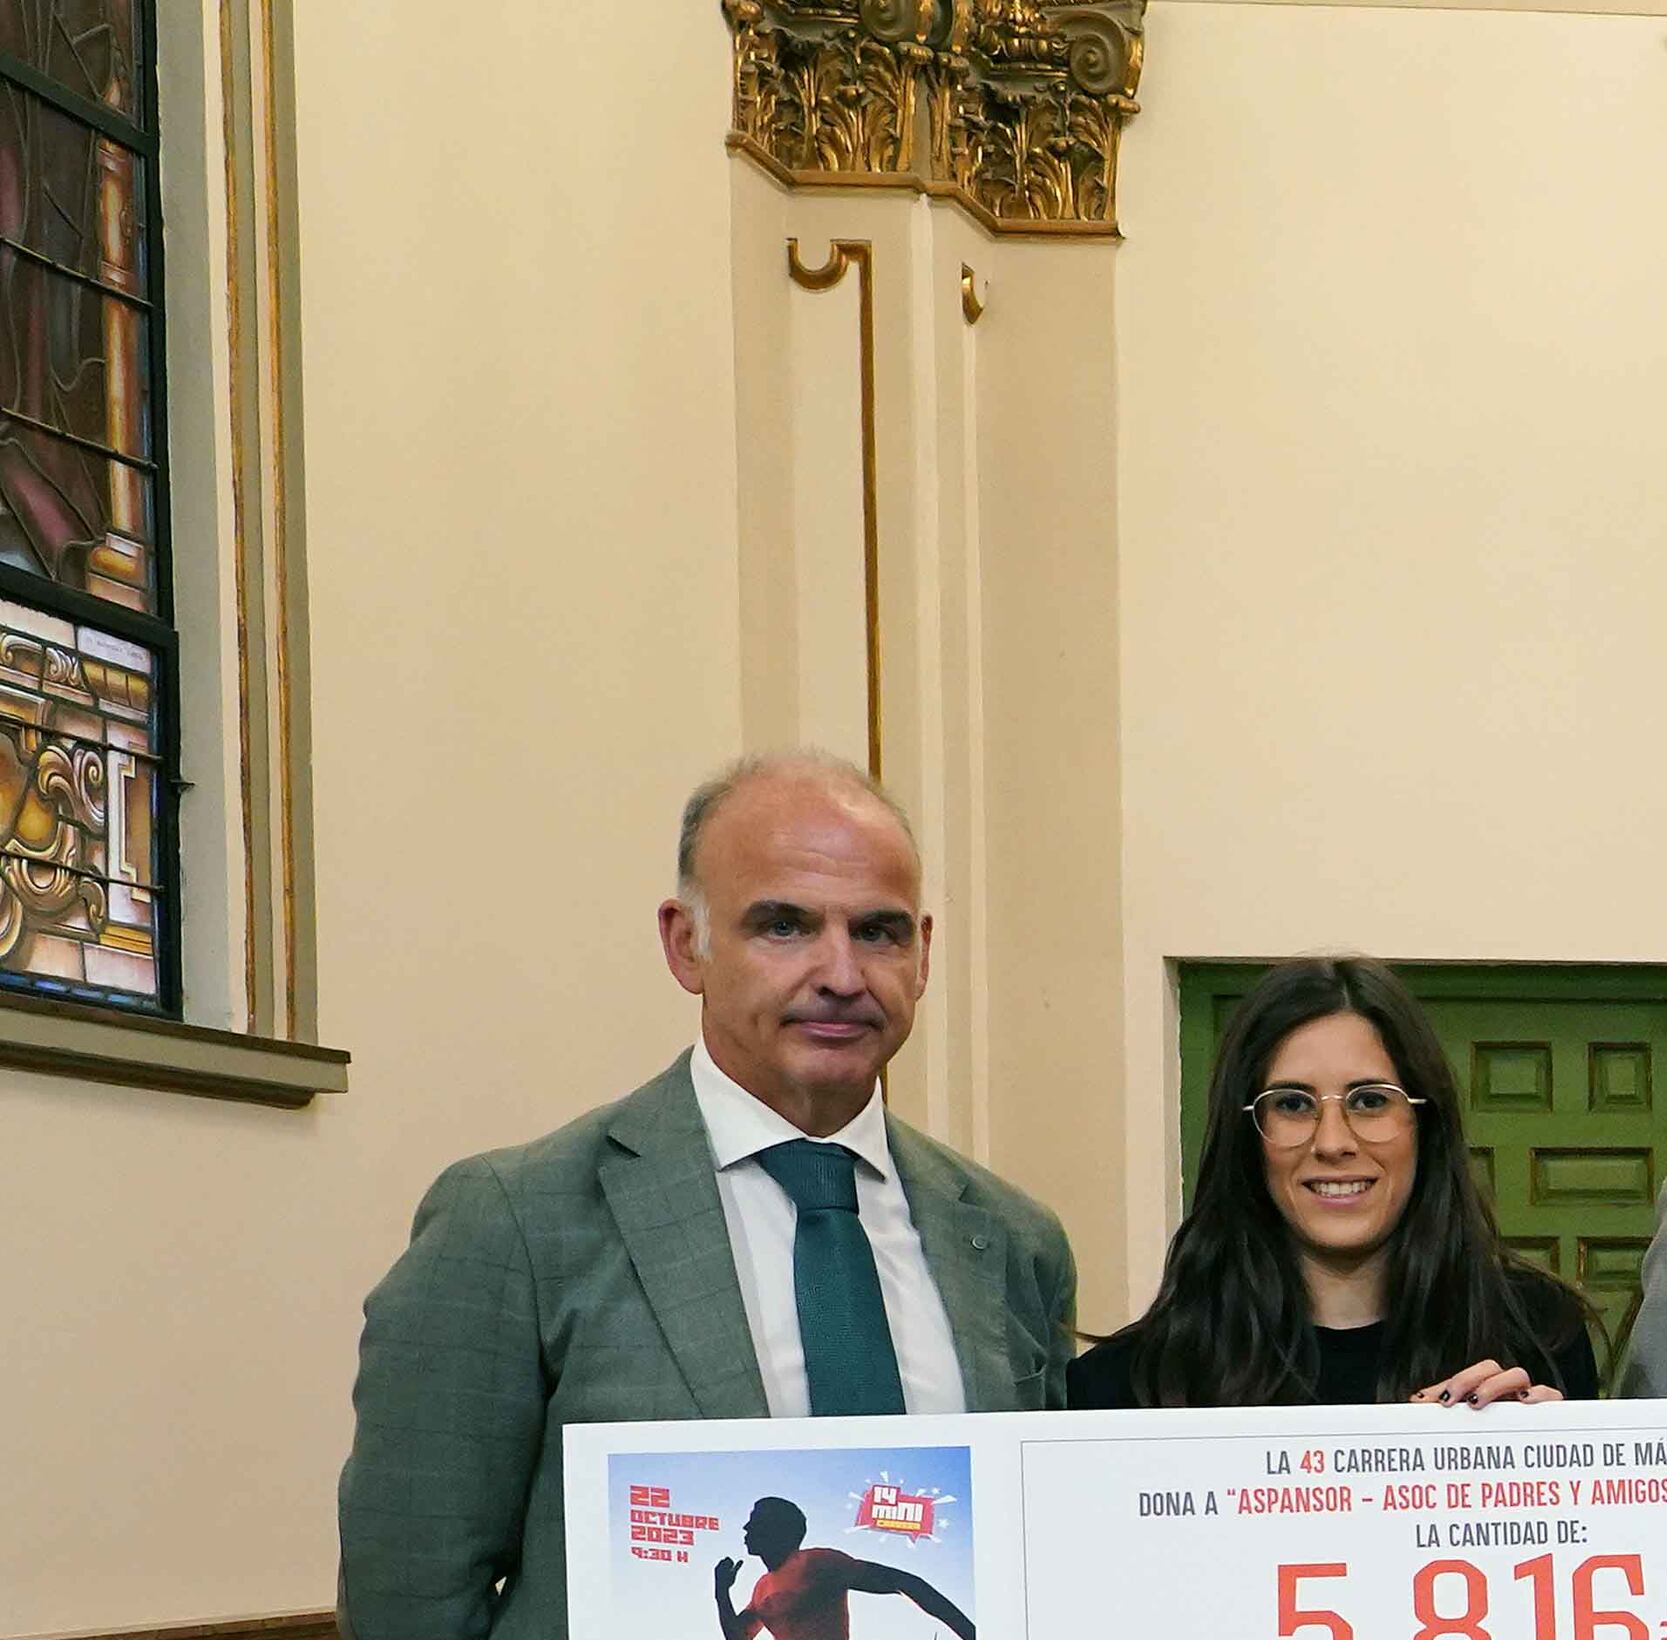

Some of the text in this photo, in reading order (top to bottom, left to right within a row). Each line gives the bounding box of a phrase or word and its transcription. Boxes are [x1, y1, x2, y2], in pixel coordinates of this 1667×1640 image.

[1267, 1451, 1291, 1475] LA
[1300, 1450, 1325, 1473] 43
[1334, 1447, 1425, 1472] CARRERA
[1434, 1444, 1515, 1471] URBANA
[1524, 1443, 1595, 1469] CIUDAD
[1603, 1443, 1626, 1466] DE
[630, 1485, 670, 1507] 22
[1139, 1490, 1195, 1516] DONA
[1204, 1490, 1218, 1515] A
[1383, 1484, 1437, 1510] ASOC
[1447, 1483, 1472, 1508] DE
[1482, 1481, 1560, 1508] PADRES
[1570, 1481, 1581, 1505] Y
[630, 1509, 719, 1530] OCTUBRE
[631, 1526, 694, 1546] 2023
[1416, 1519, 1588, 1548] LA CANTIDAD DE:
[631, 1547, 672, 1561] 9:30
